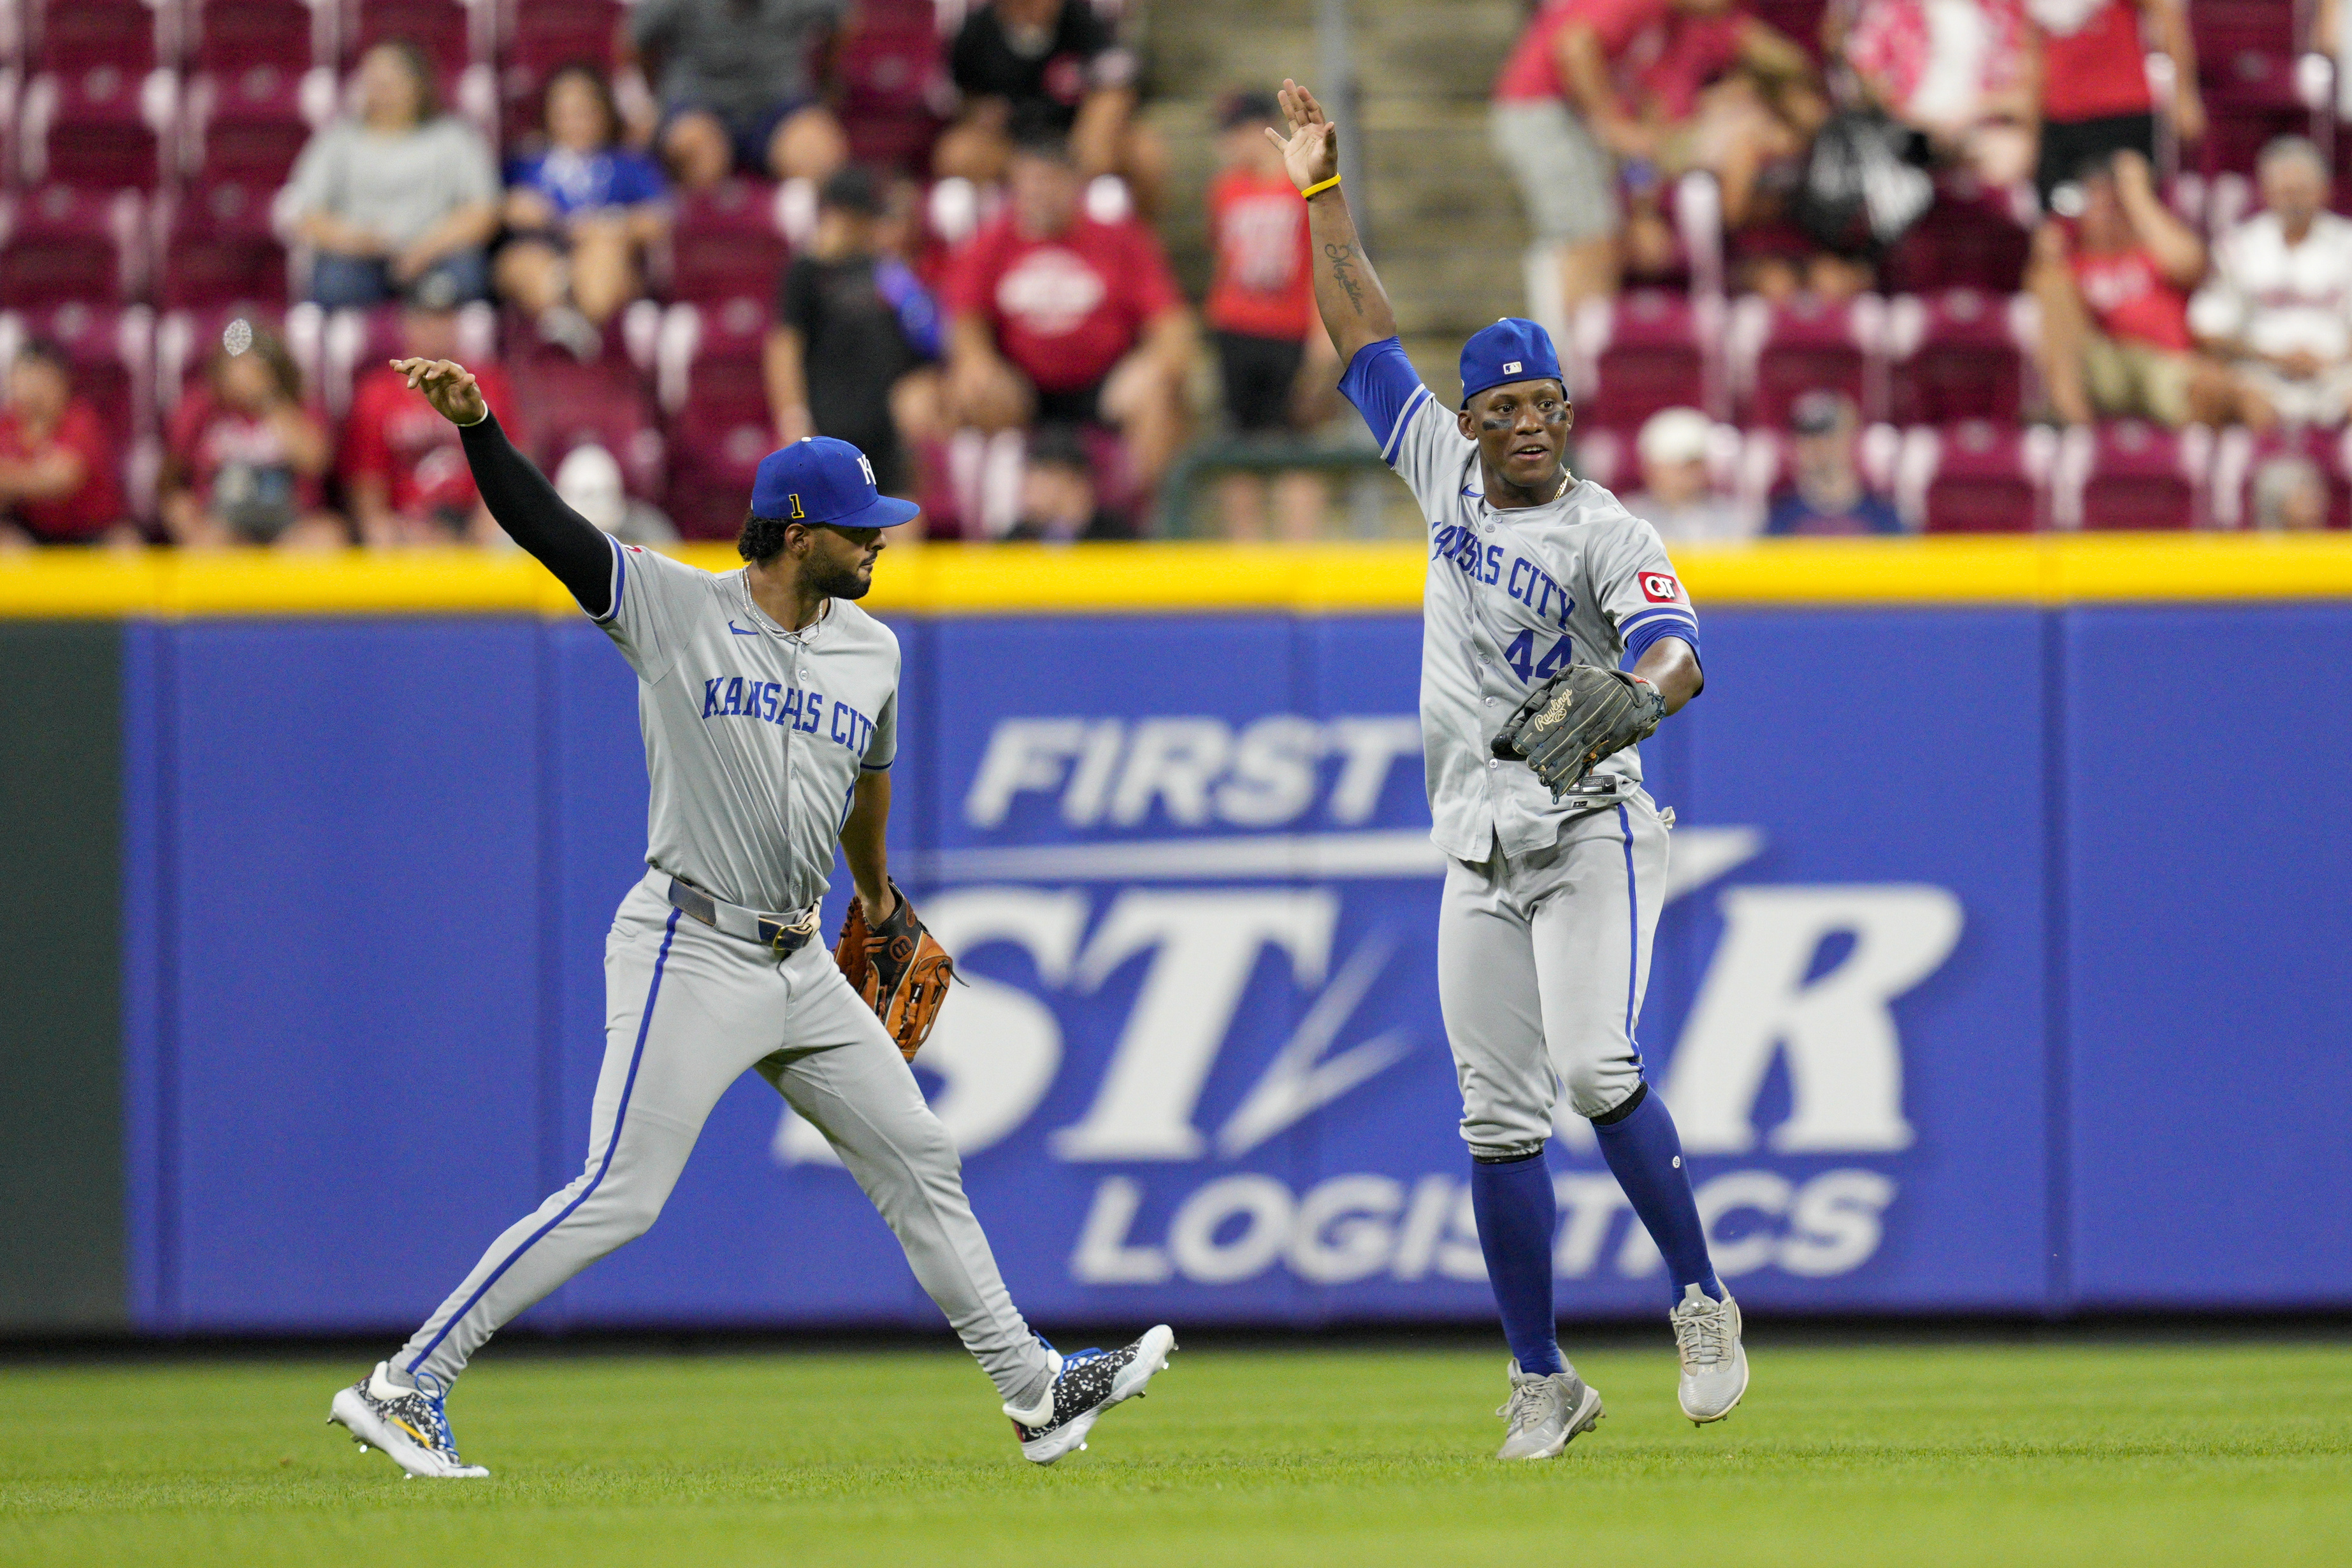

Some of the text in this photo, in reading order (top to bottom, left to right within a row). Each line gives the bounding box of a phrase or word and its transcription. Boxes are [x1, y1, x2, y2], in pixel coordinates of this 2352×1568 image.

[789, 493, 805, 519] 1
[1431, 521, 1576, 632] ANSAS CITY
[1645, 575, 1676, 598] QT
[1504, 628, 1573, 686] 44
[702, 677, 876, 759] KANSAS CIT
[1534, 688, 1573, 732] Rawlings
[965, 716, 1426, 827] FIRST
